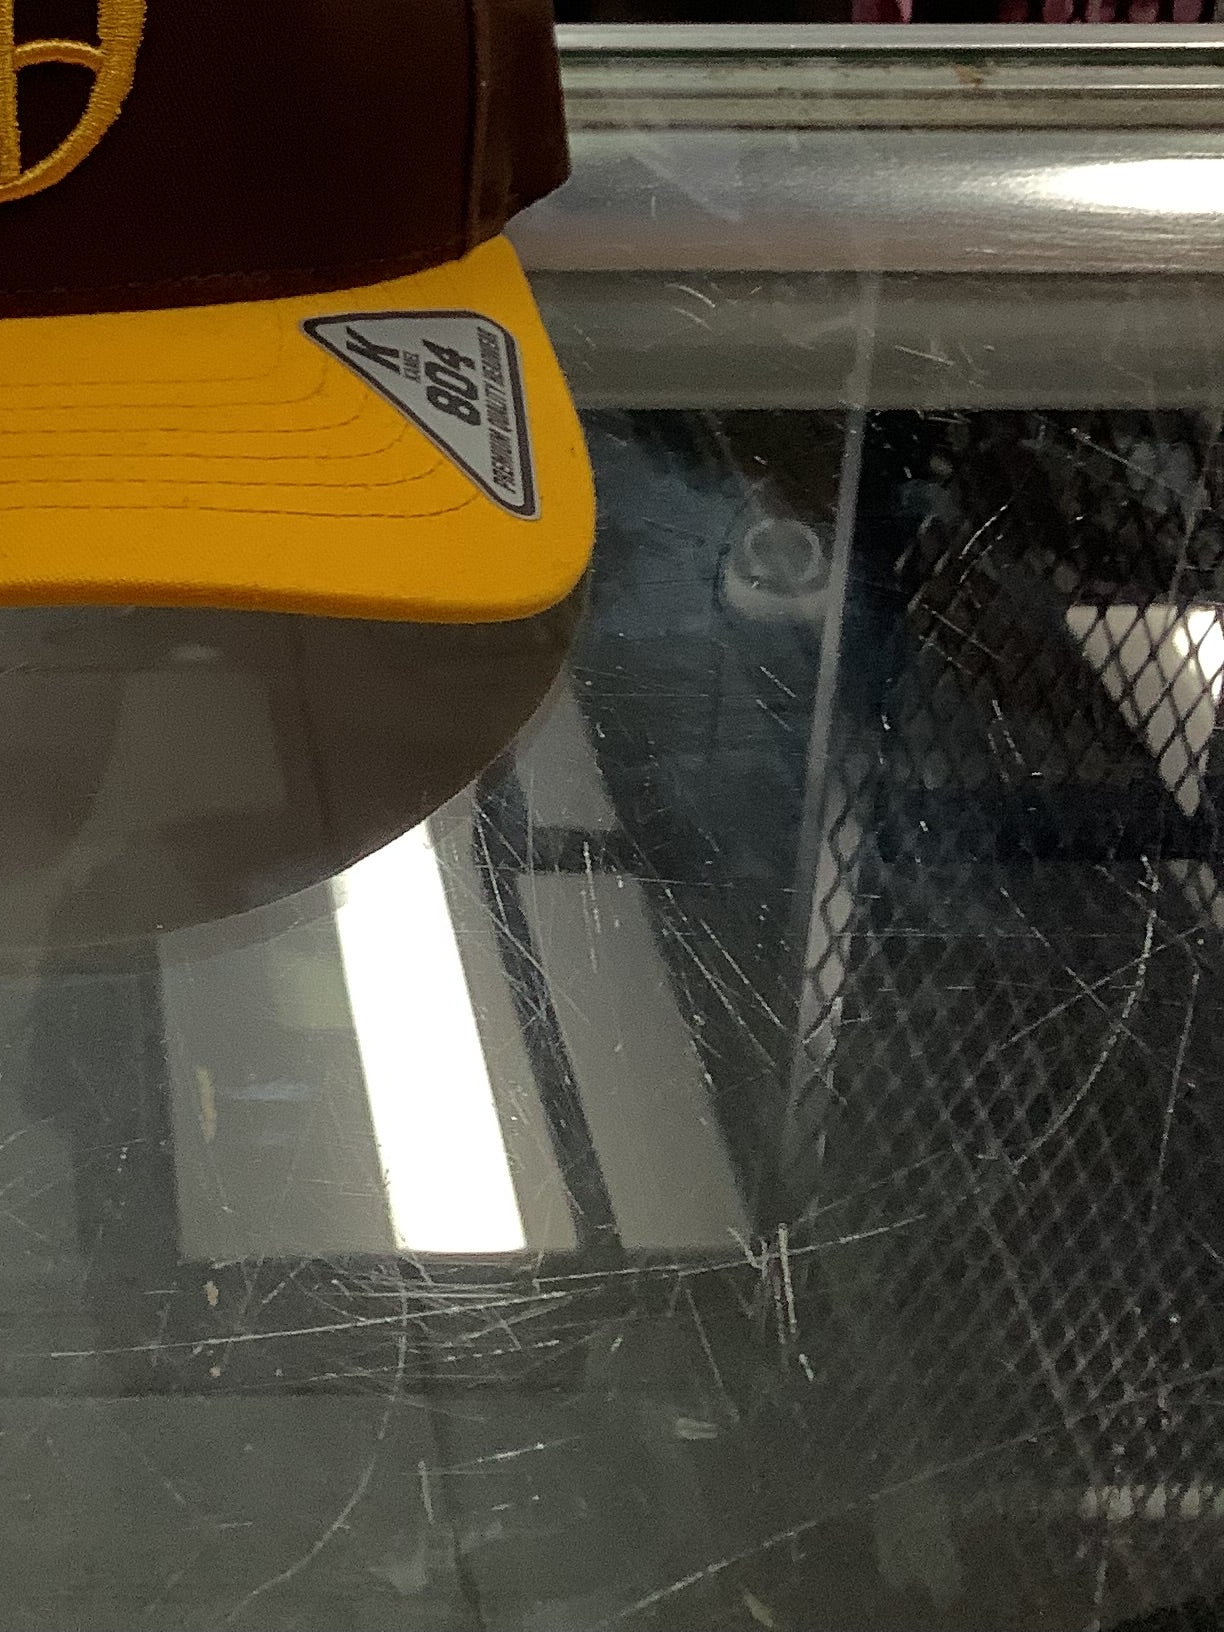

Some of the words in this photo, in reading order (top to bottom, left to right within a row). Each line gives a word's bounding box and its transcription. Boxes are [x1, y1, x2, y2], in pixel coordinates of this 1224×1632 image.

[422, 338, 481, 426] 804
[483, 379, 512, 433] QUALITY
[489, 426, 516, 494] PREMIUM
